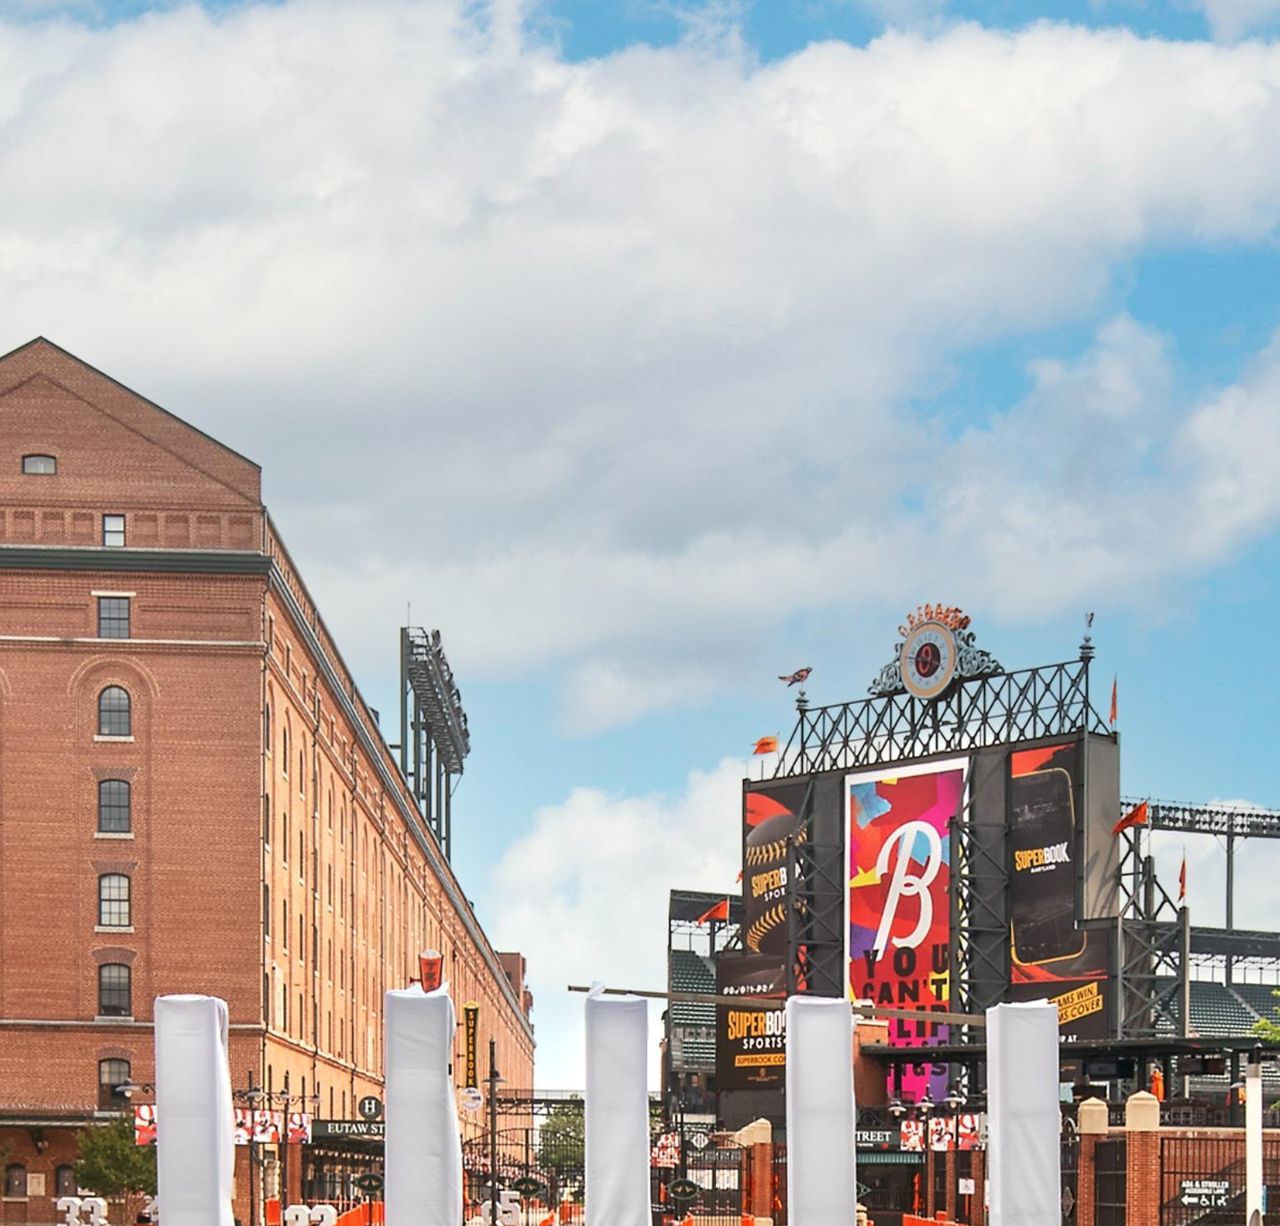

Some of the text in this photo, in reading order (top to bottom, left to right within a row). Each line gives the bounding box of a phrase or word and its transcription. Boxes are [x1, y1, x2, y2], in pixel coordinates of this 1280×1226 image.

[1014, 841, 1071, 872] SUPERBOOK
[862, 943, 949, 979] YOU
[862, 978, 948, 1004] CAN'T
[1076, 986, 1096, 1000] WIN
[1070, 998, 1101, 1018] COVER
[327, 1122, 369, 1134] EUTAW
